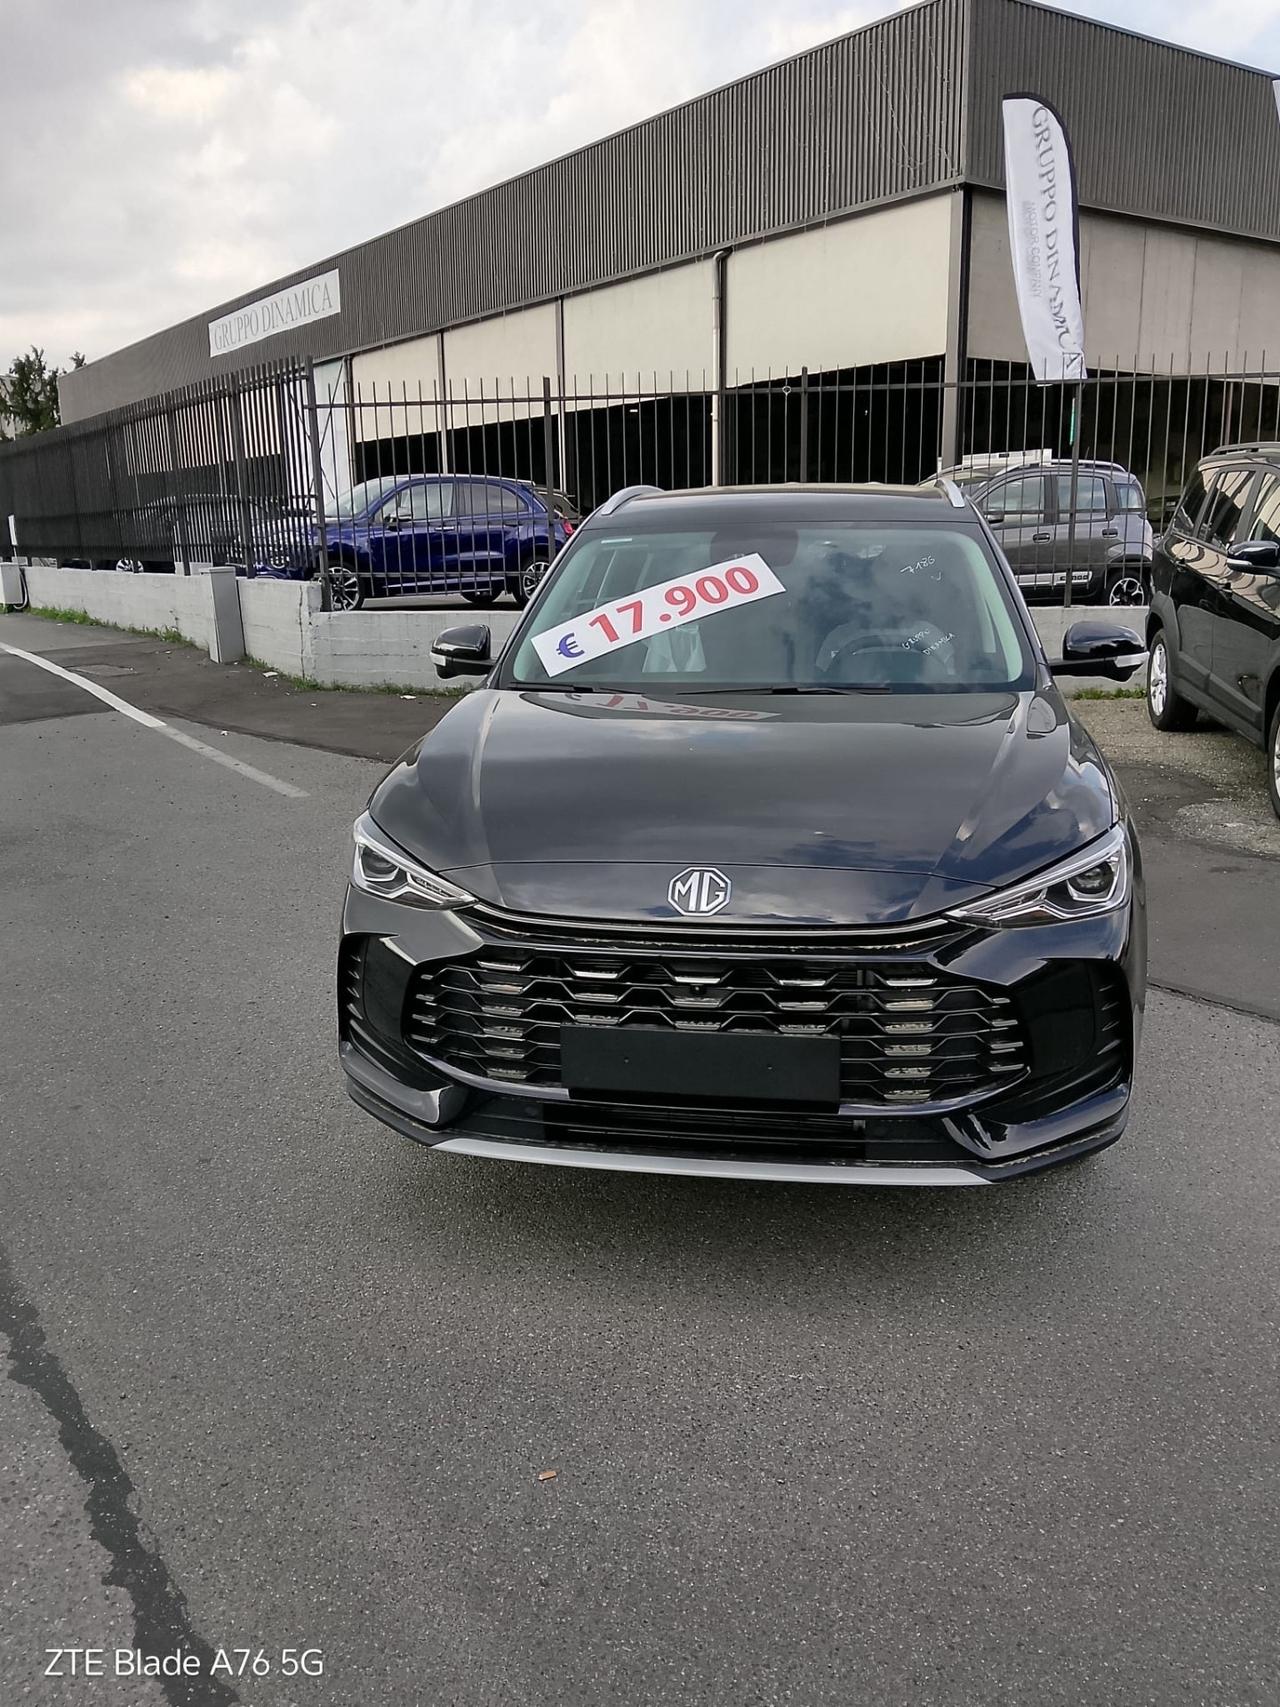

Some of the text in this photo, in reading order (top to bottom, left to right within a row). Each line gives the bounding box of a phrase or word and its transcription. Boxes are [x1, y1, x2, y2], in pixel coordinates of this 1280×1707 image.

[1032, 106, 1057, 222] GRUPPO
[214, 281, 333, 350] GRUPPO DINAMICA
[556, 566, 760, 659] € 17.900
[673, 871, 726, 912] MG
